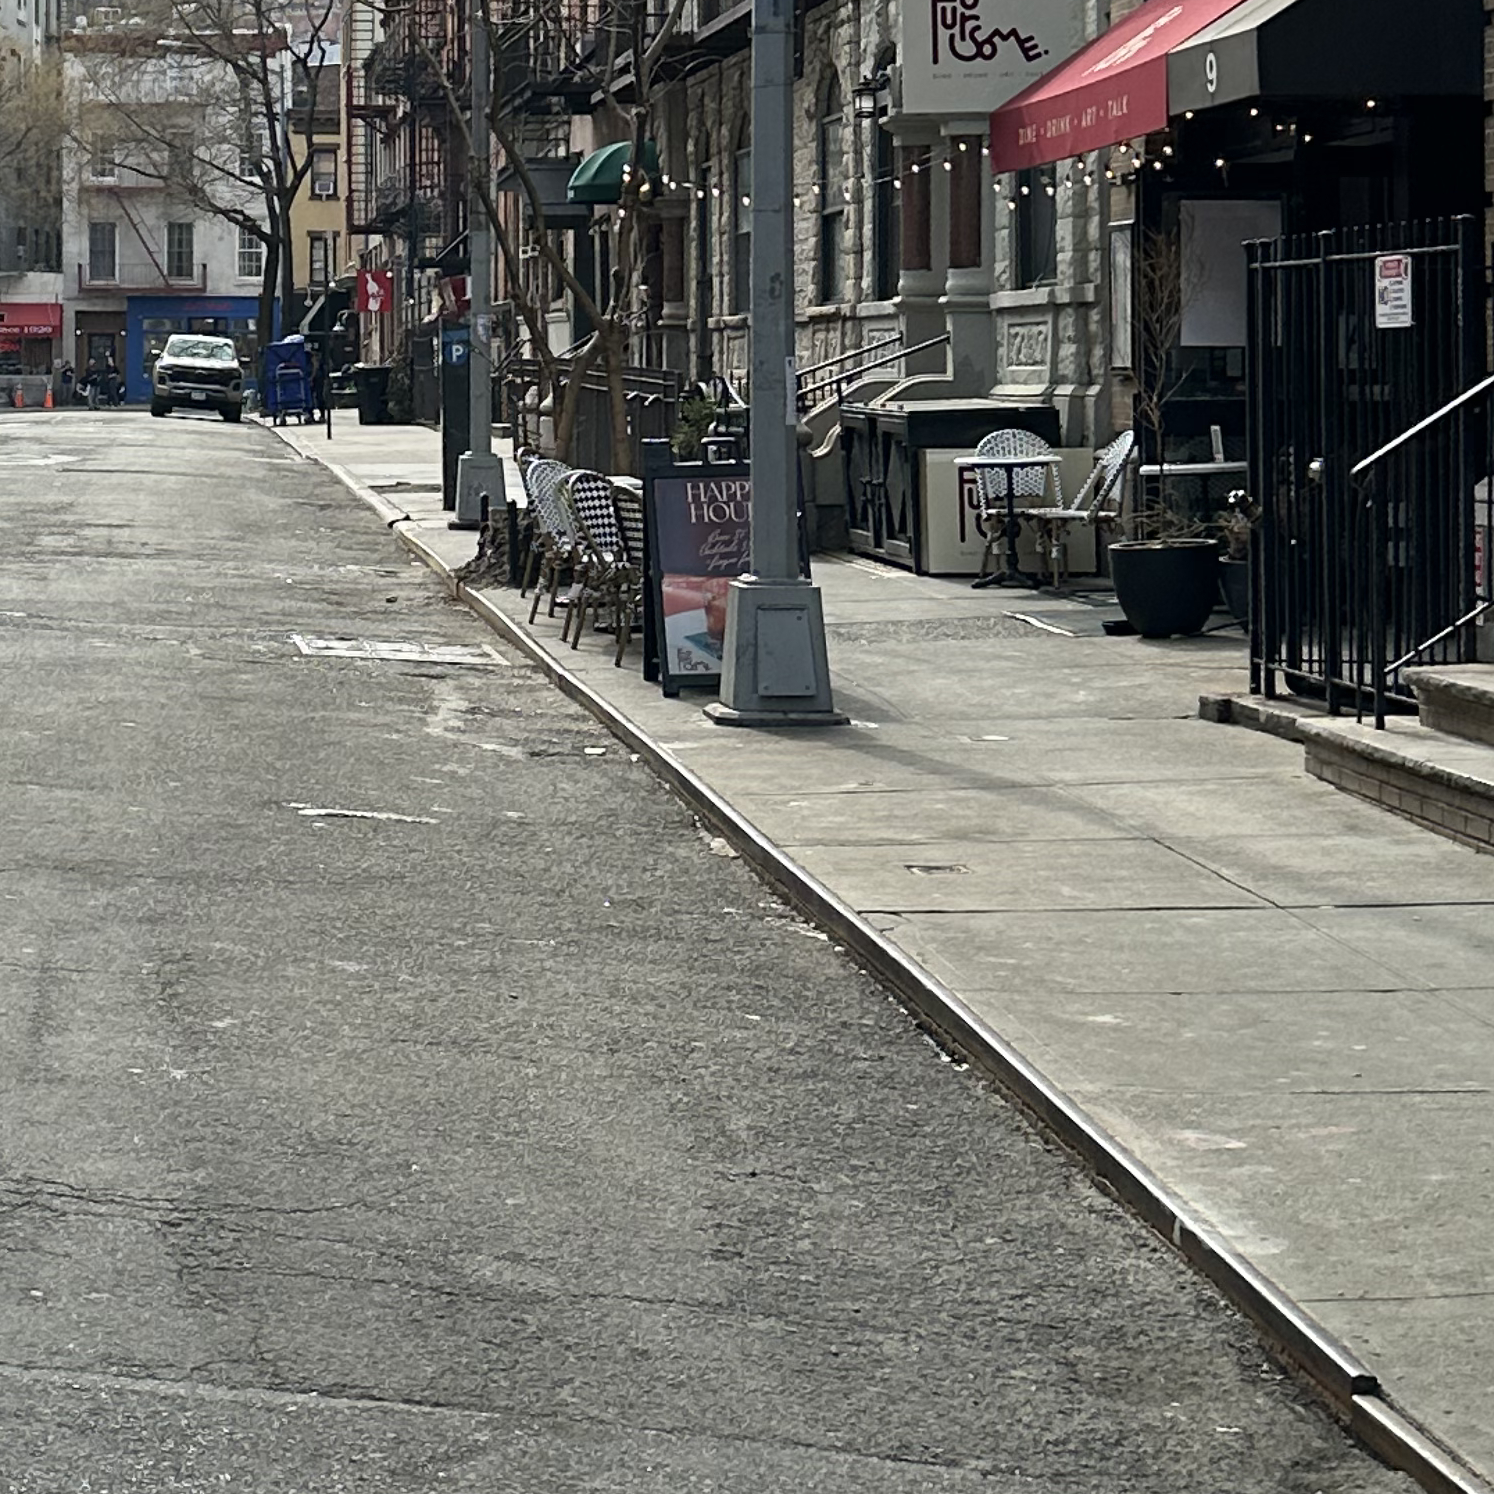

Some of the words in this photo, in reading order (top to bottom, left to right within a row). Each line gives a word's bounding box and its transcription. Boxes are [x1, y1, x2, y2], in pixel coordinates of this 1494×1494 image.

[1206, 52, 1217, 93] 9
[1046, 114, 1071, 139] DRINK
[1081, 105, 1097, 129] ART
[1107, 94, 1128, 121] TALK
[452, 344, 464, 362] P
